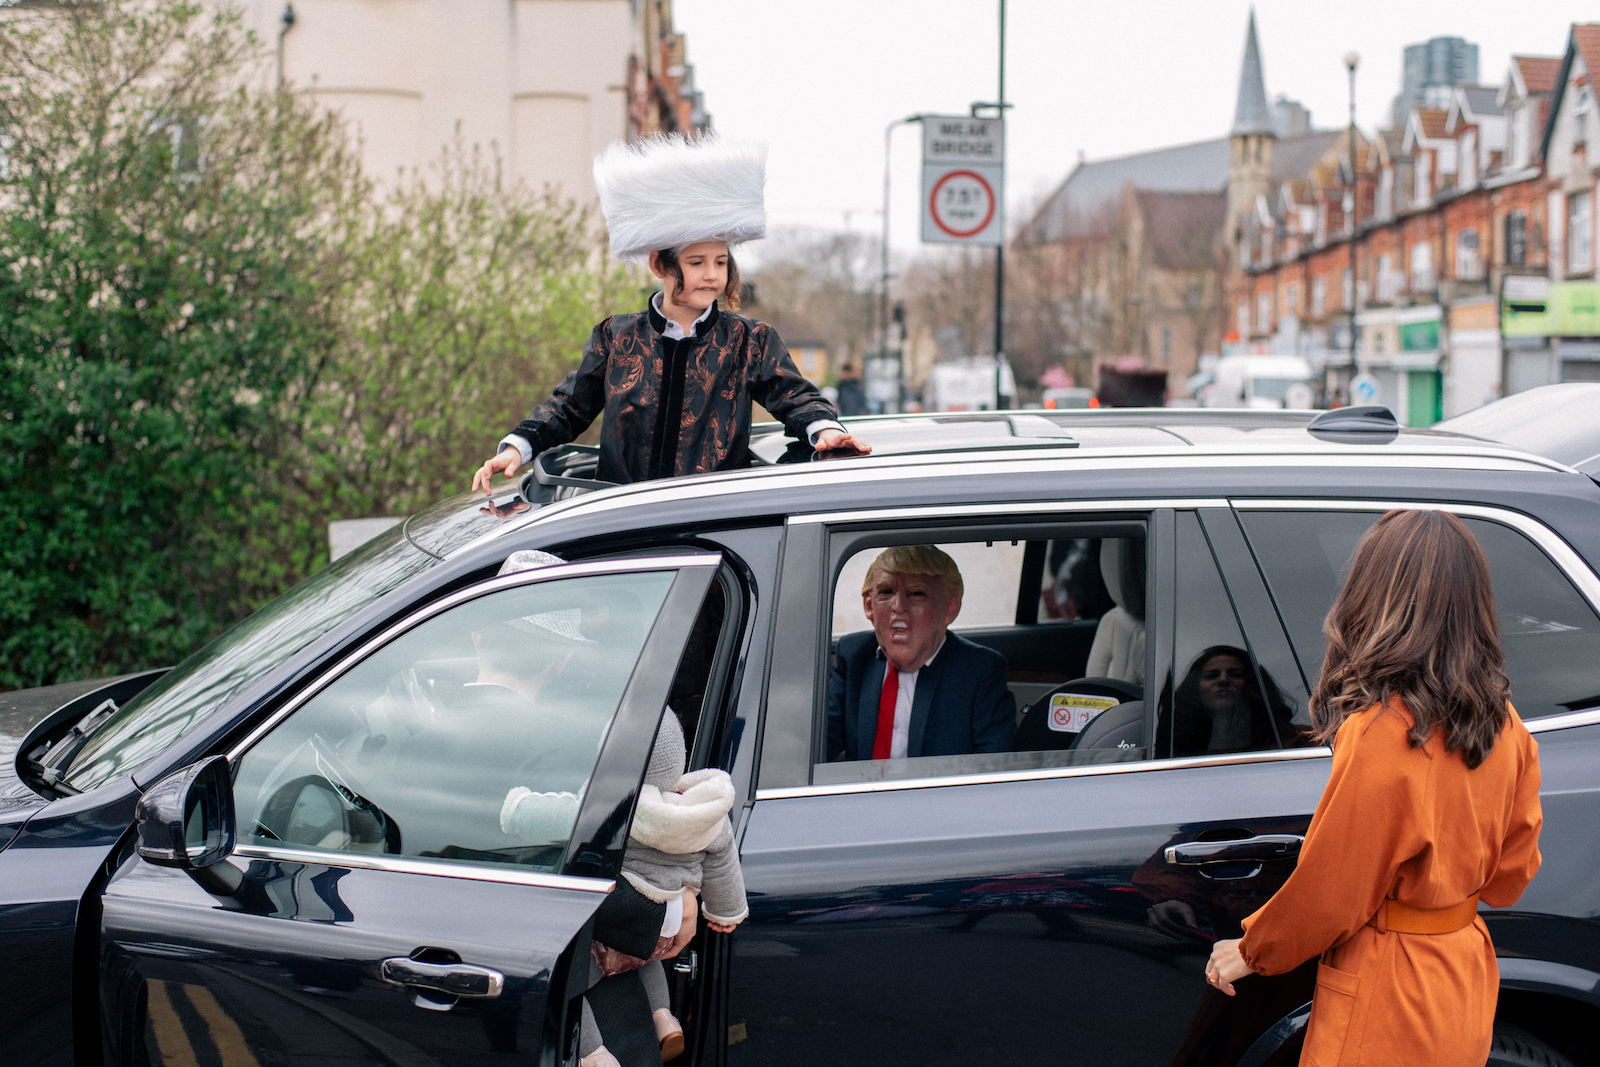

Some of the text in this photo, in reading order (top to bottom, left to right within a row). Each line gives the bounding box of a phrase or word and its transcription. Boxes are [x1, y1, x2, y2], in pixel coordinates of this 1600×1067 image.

[940, 123, 987, 135] WEAK
[931, 140, 994, 155] BRIDGE
[1072, 699, 1097, 707] AIRBAG
